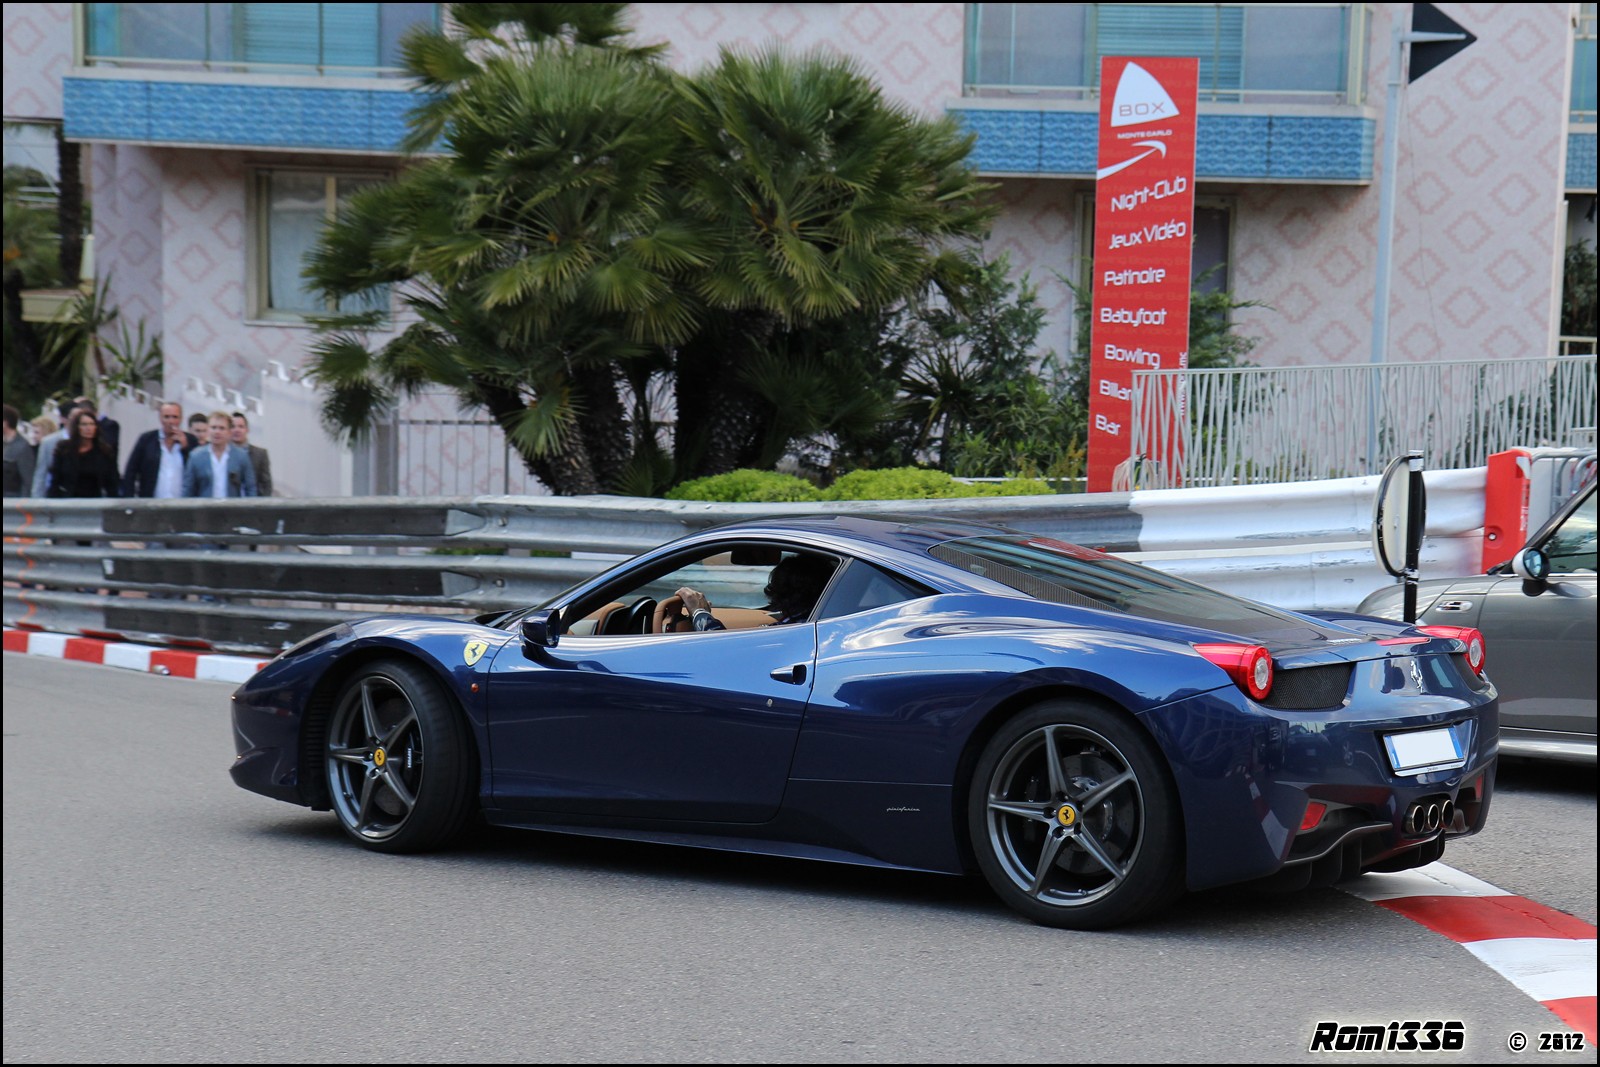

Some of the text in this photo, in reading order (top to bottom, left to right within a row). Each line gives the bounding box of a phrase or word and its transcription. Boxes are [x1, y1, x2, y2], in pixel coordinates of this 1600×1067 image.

[1118, 102, 1165, 117] BOX
[1111, 176, 1187, 212] Night-Club
[1108, 219, 1187, 249] Jeux Vidéo
[1104, 267, 1166, 286] Patinoire
[1100, 307, 1167, 327] Babyfoot
[1104, 344, 1161, 370] Bowling
[1099, 379, 1138, 402] Billar
[1095, 413, 1121, 436] Bar
